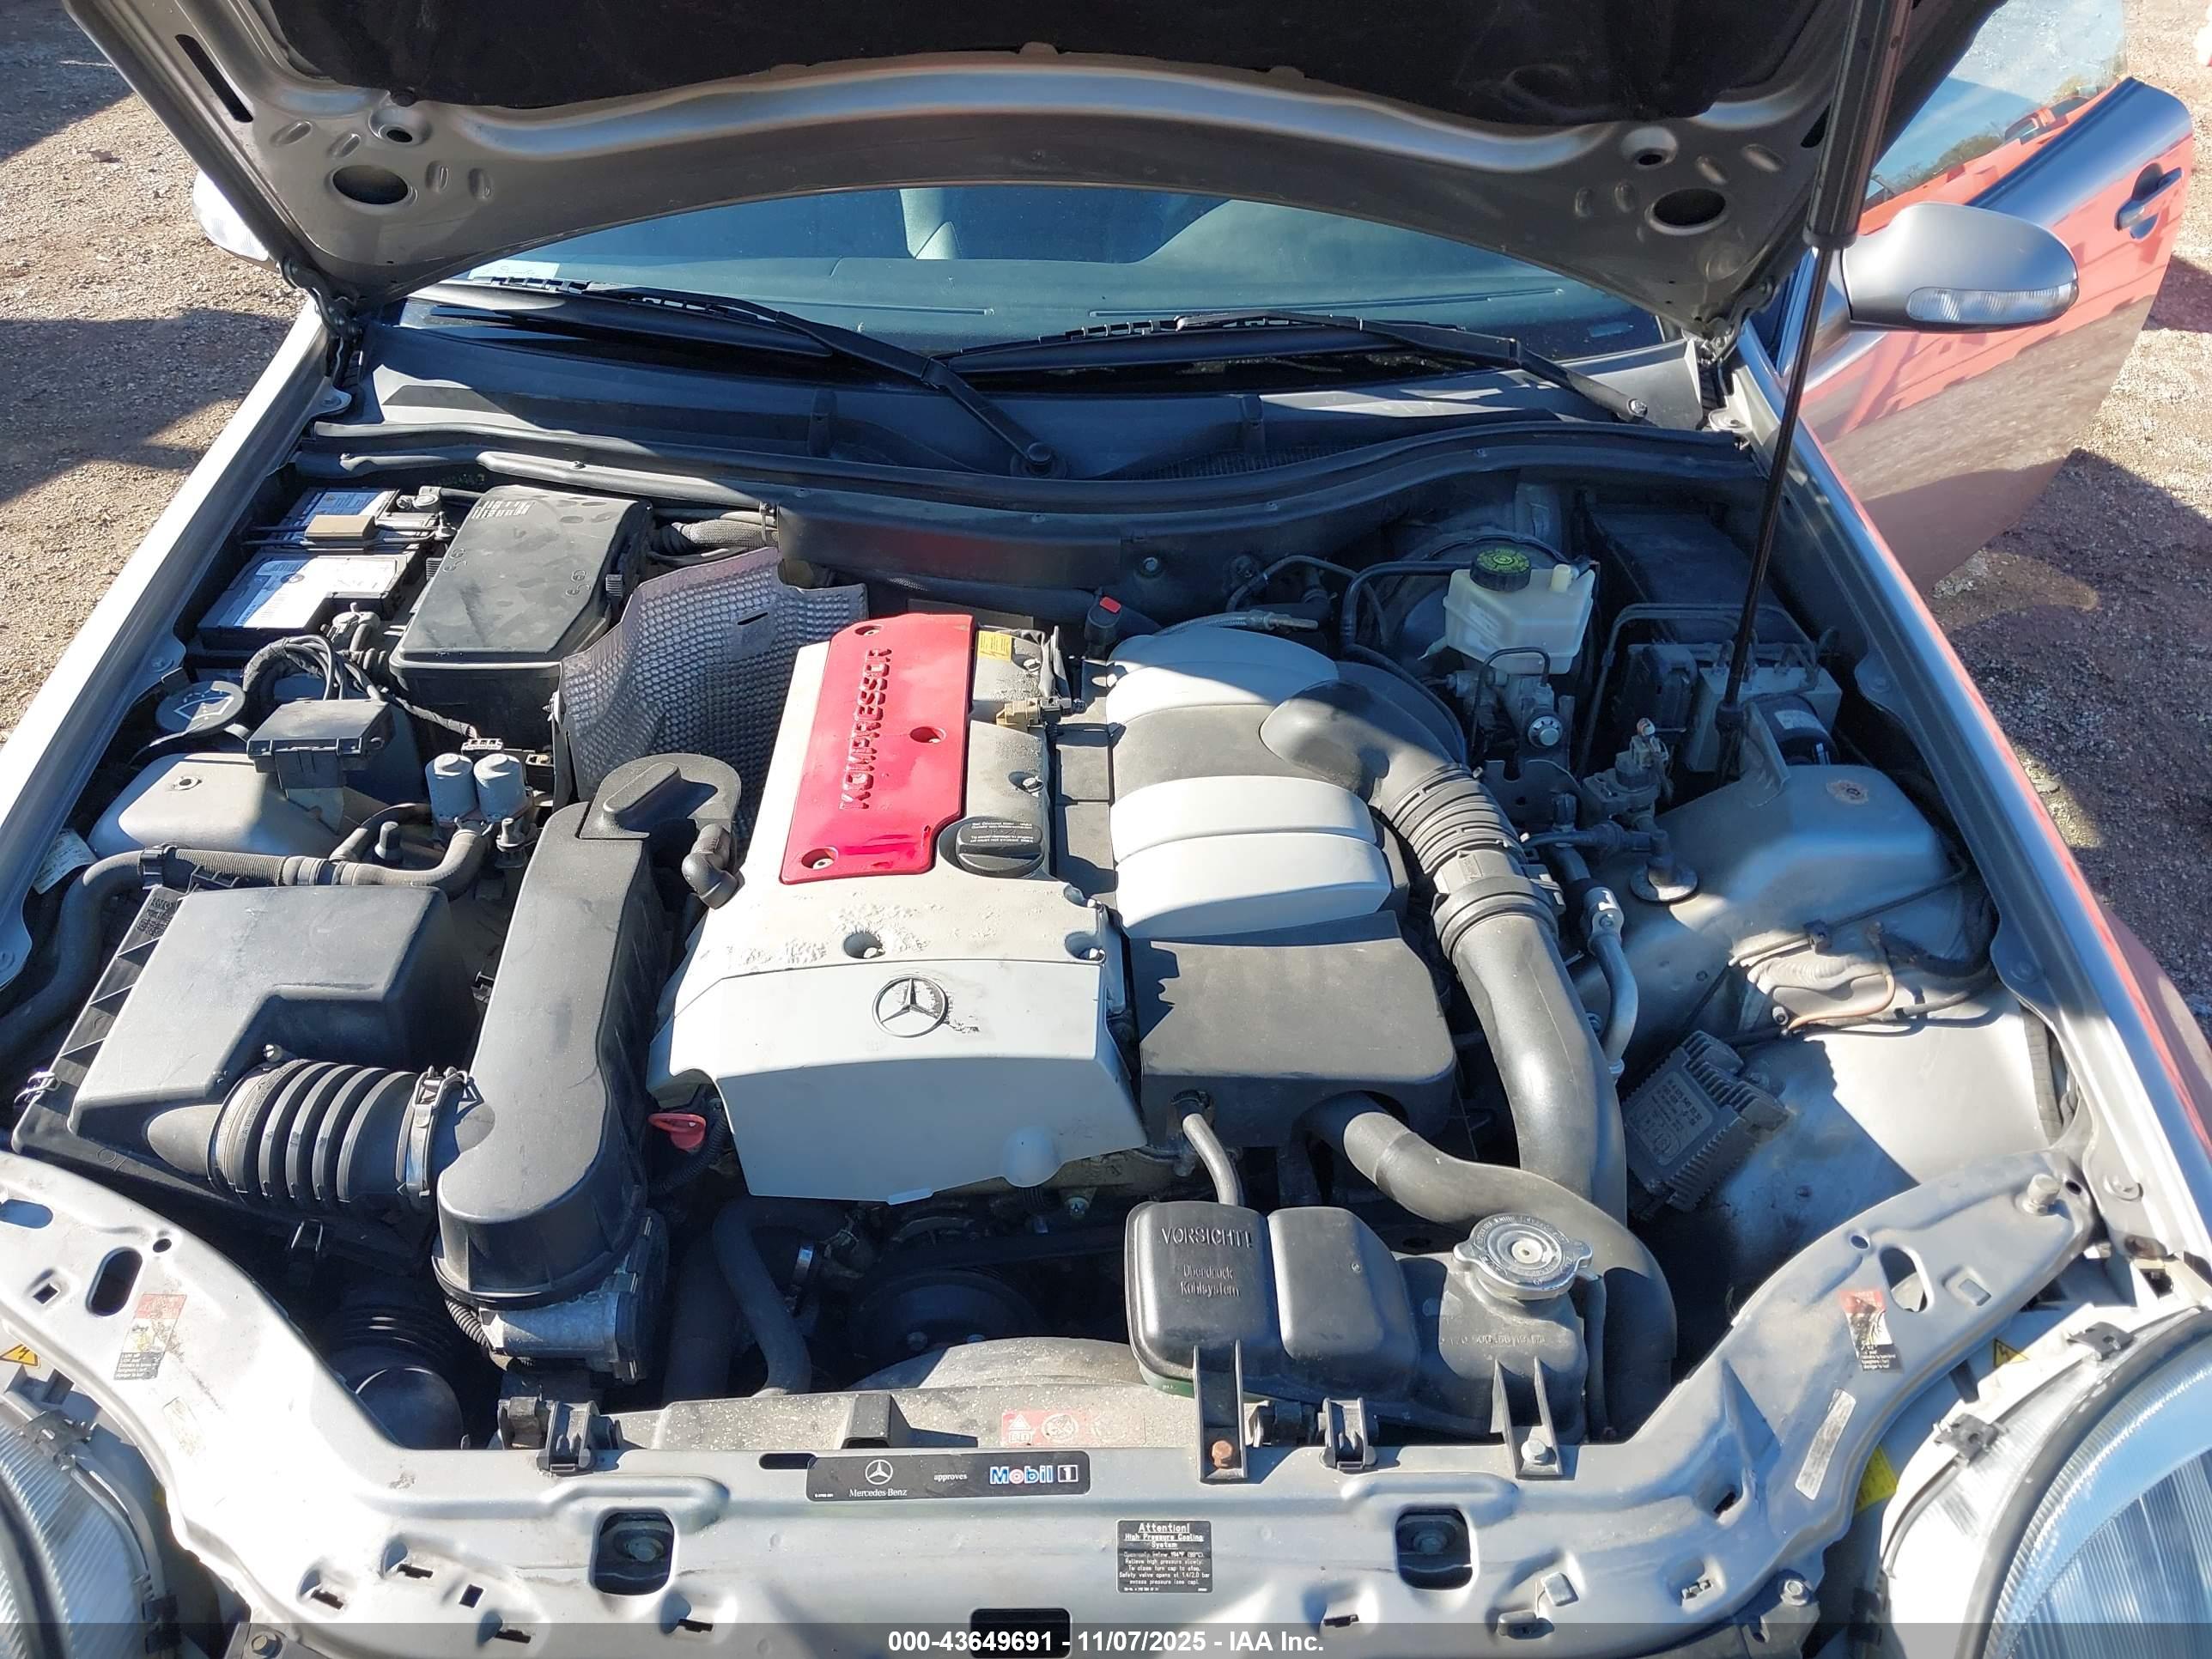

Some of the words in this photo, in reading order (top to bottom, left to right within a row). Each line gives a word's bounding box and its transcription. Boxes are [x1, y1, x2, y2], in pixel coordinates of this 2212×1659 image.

[839, 648, 892, 810] KOMPRESSOR
[1161, 1226, 1253, 1249] VORSICHT!
[934, 1473, 968, 1482] approves
[990, 1465, 1053, 1485] Mobil
[849, 1488, 908, 1498] Mercedes-Benz
[1138, 1522, 1190, 1532] Attention!
